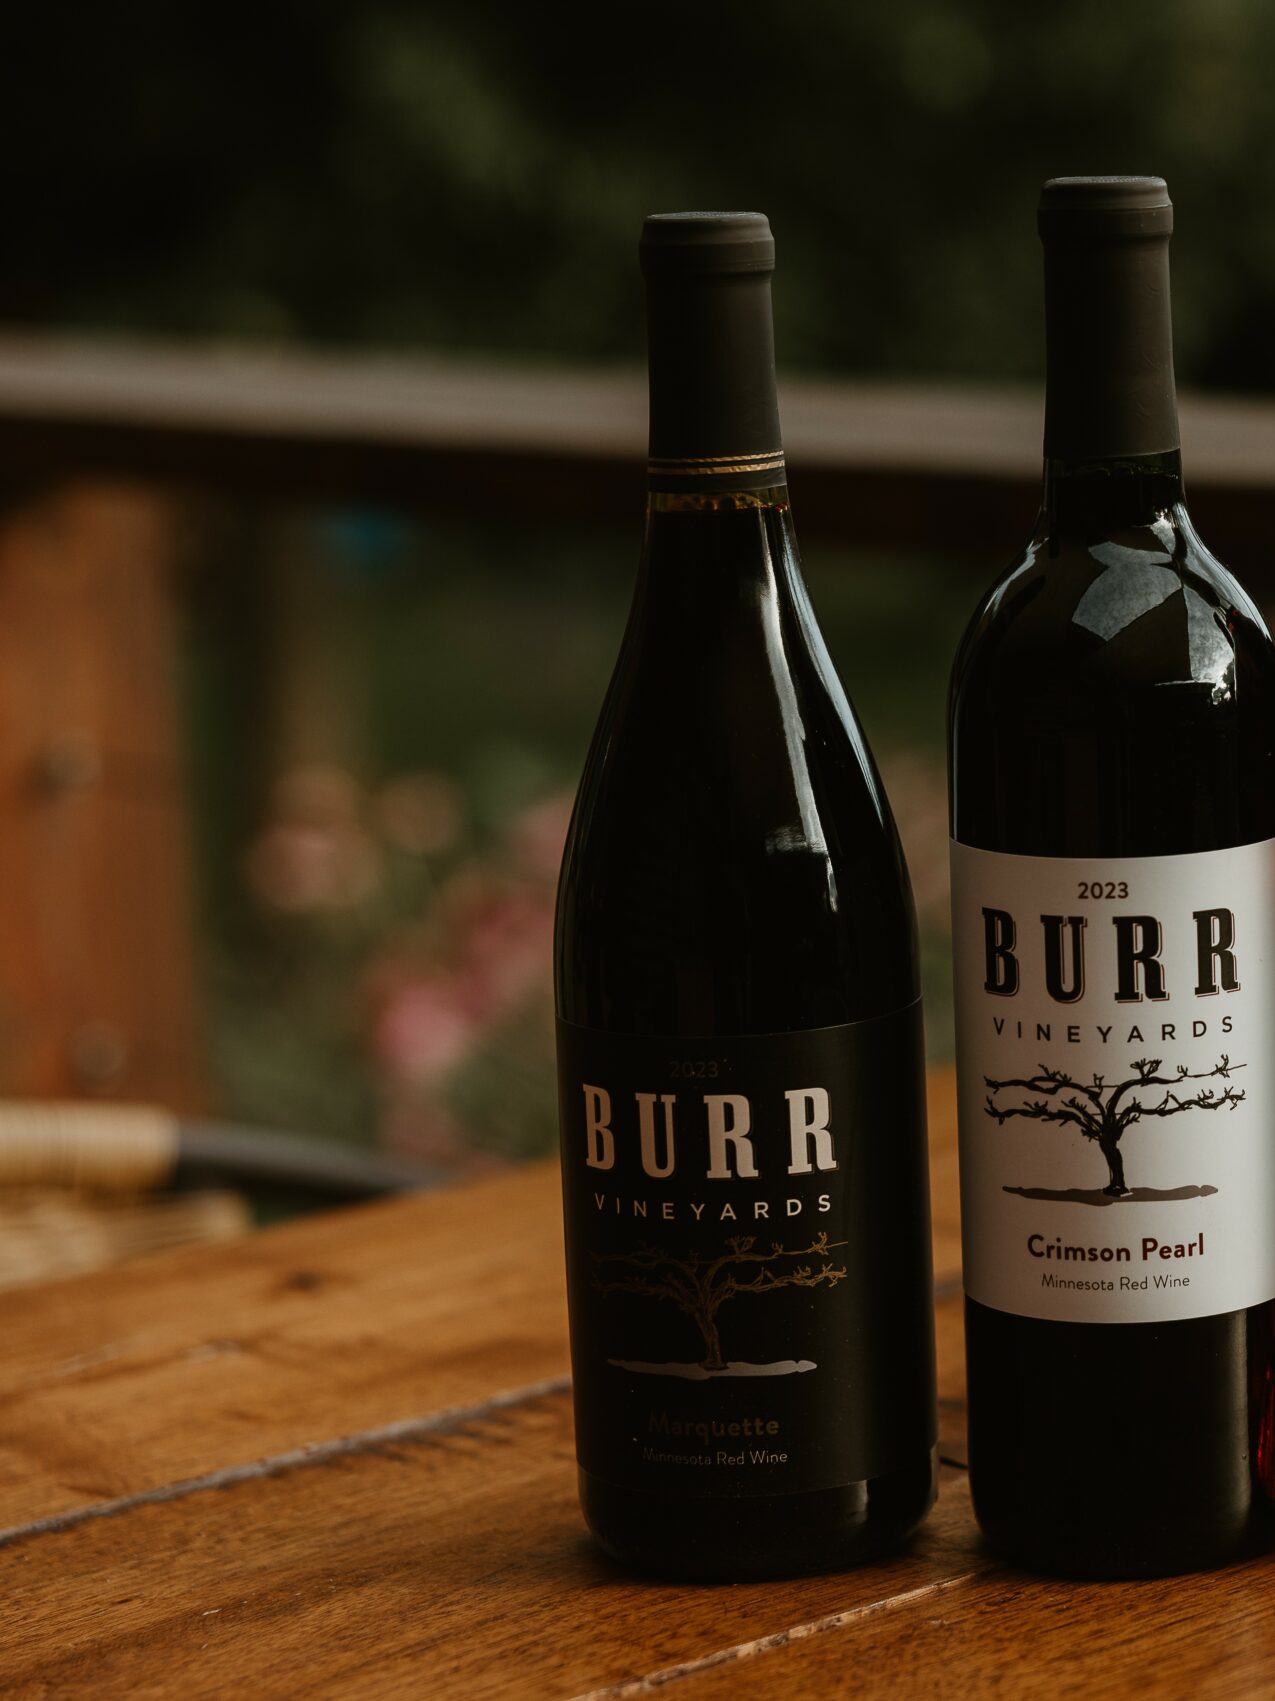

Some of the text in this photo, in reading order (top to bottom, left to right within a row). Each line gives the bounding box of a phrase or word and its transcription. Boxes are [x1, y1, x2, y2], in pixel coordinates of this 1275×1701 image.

[1077, 881, 1129, 900] 2023
[982, 906, 1241, 1004] BURR
[993, 1016, 1233, 1043] VINEYARDS
[669, 1060, 719, 1078] 2023
[582, 1083, 840, 1180] BURR
[594, 1194, 831, 1220] VINEYARDS
[1027, 1232, 1205, 1263] Crimson Pearl
[1041, 1273, 1190, 1292] Minnesota Red Wine
[649, 1412, 780, 1446] Marquette
[642, 1447, 788, 1466] Minnesota Red Wine
